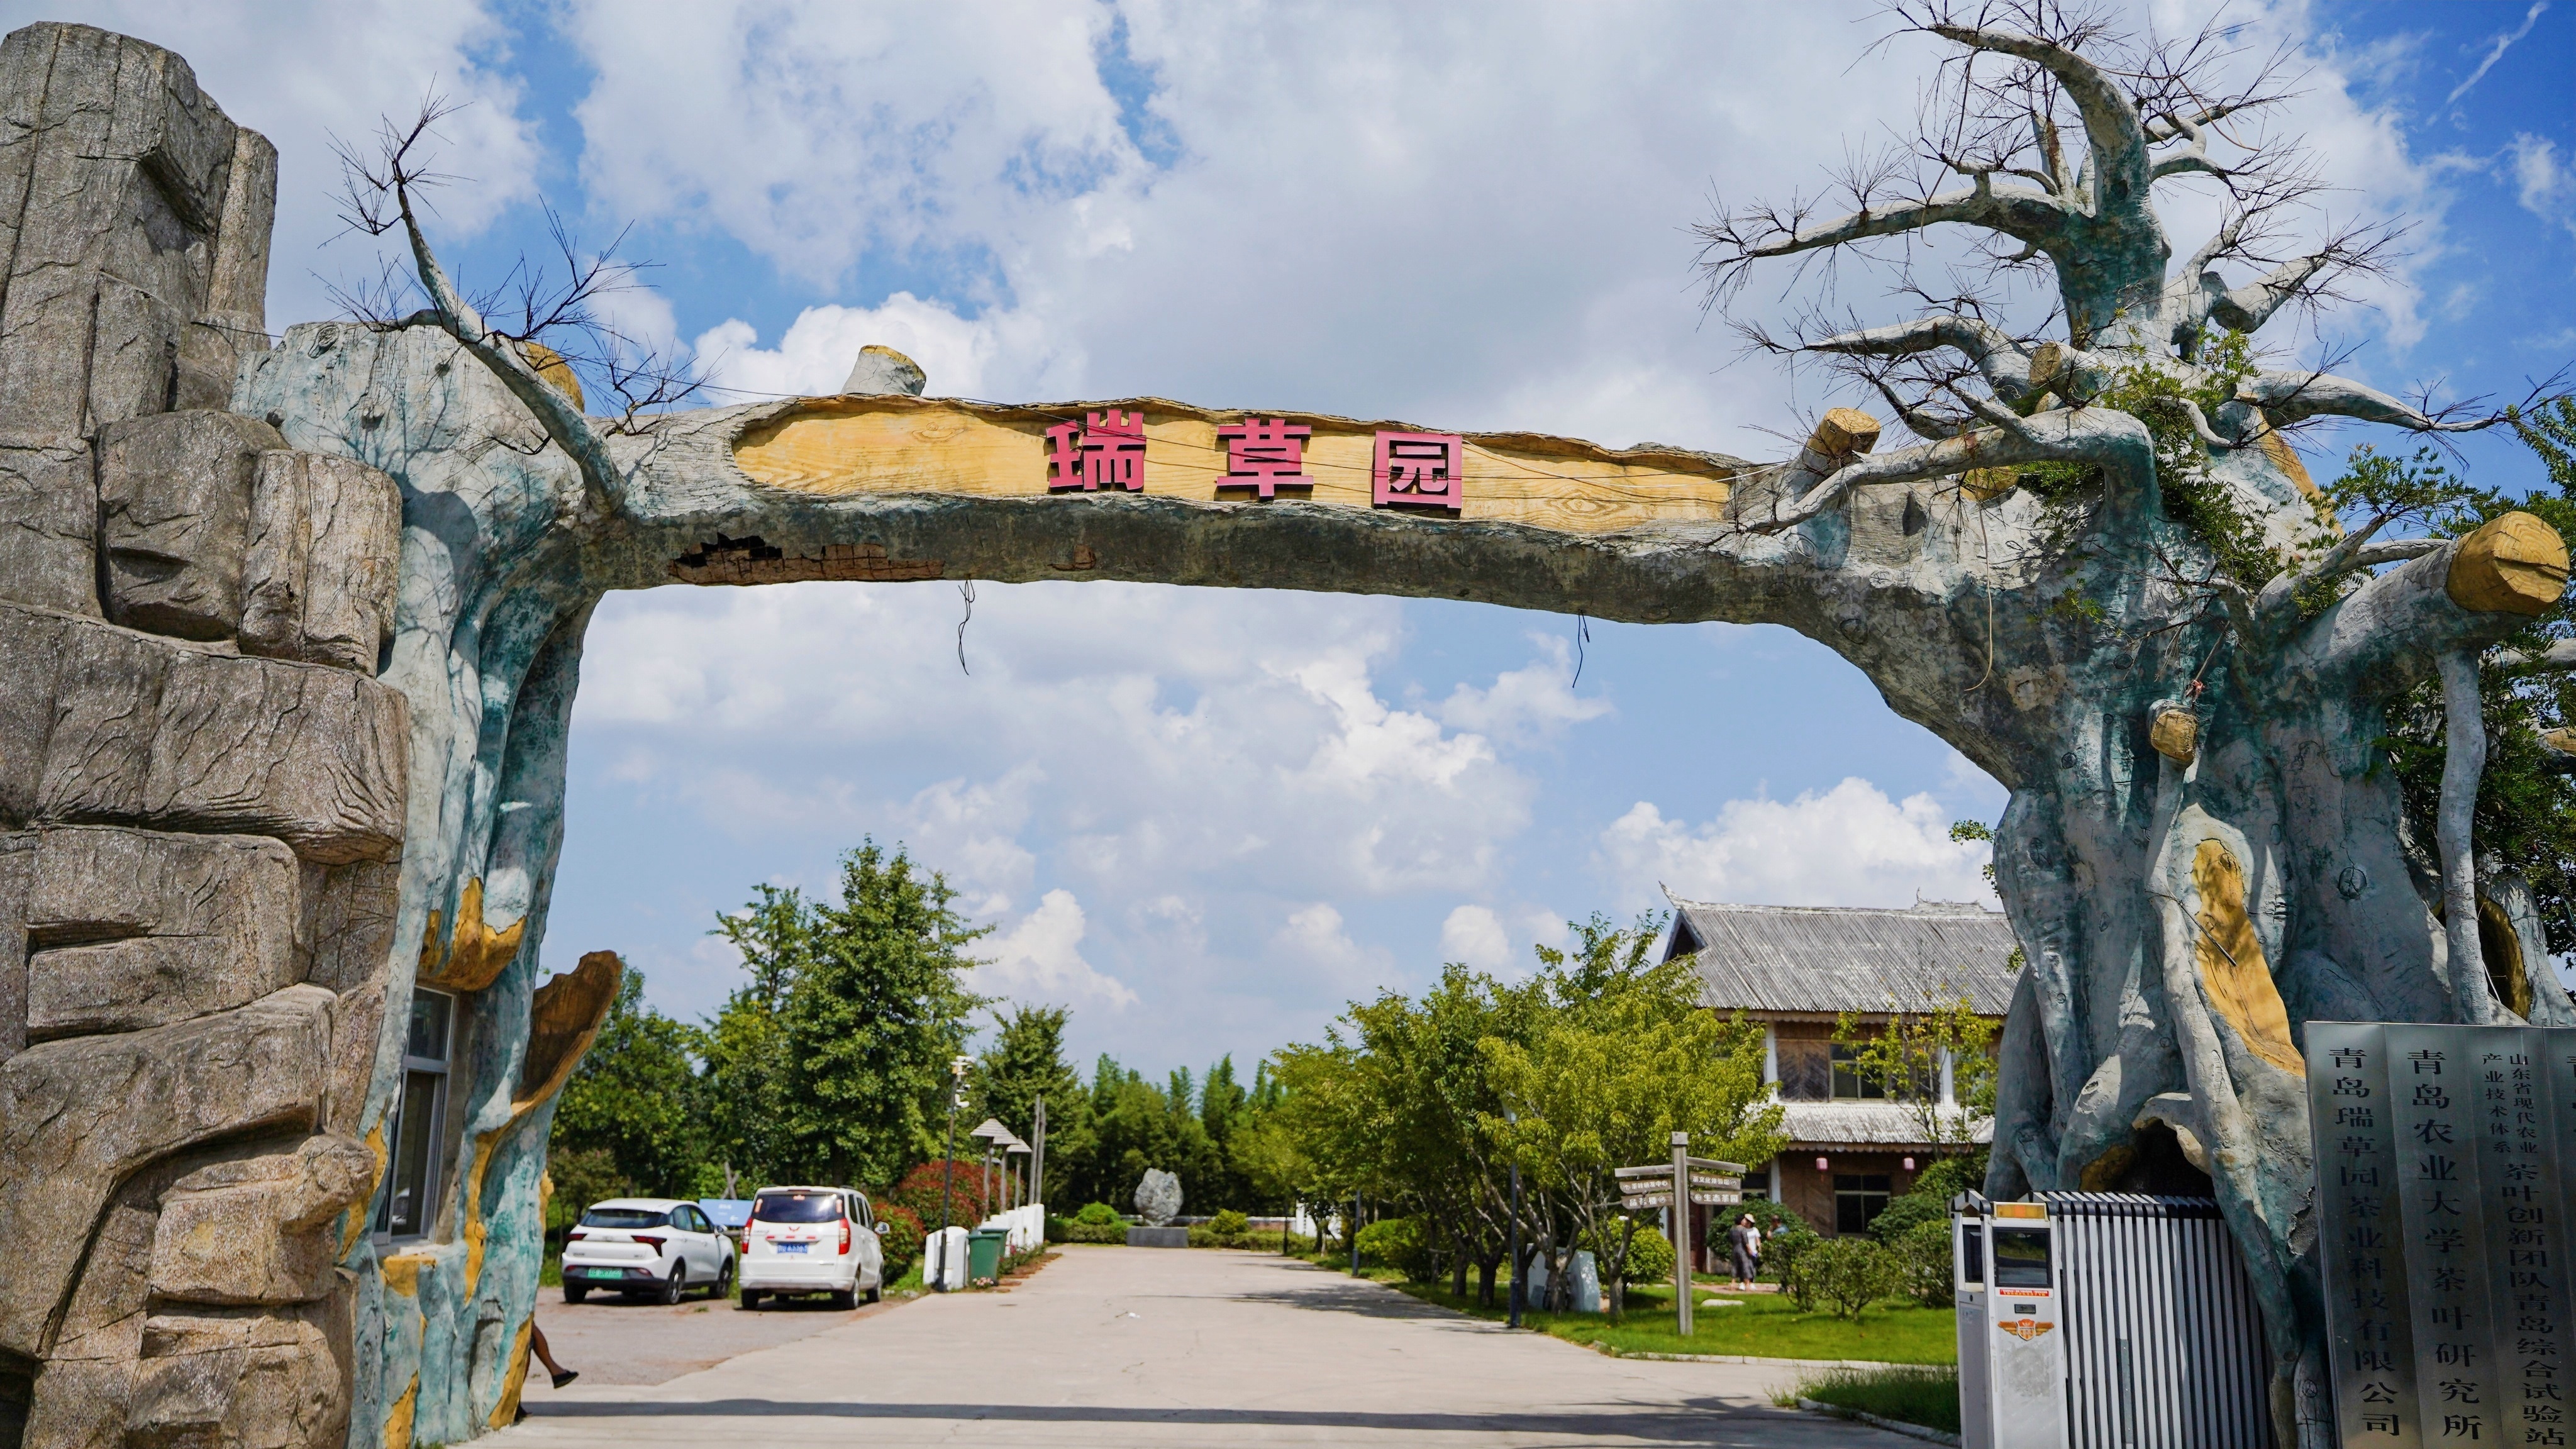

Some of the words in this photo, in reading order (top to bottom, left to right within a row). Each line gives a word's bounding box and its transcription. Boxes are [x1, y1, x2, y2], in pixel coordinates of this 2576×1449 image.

[1045, 409, 1463, 509] 瑞草园
[2482, 1053, 2511, 1153] 产业技术体系
[2509, 1053, 2538, 1154] 山东省现代农业
[1703, 1194, 1739, 1203] 生态茶园
[2328, 1047, 2400, 1437] 青岛瑞草园茶业科技有限公司
[2407, 1049, 2484, 1440] 青岛农业大学茶叶研究所
[2501, 1163, 2566, 1446] 茶叶创新团队青岛综合试验站
